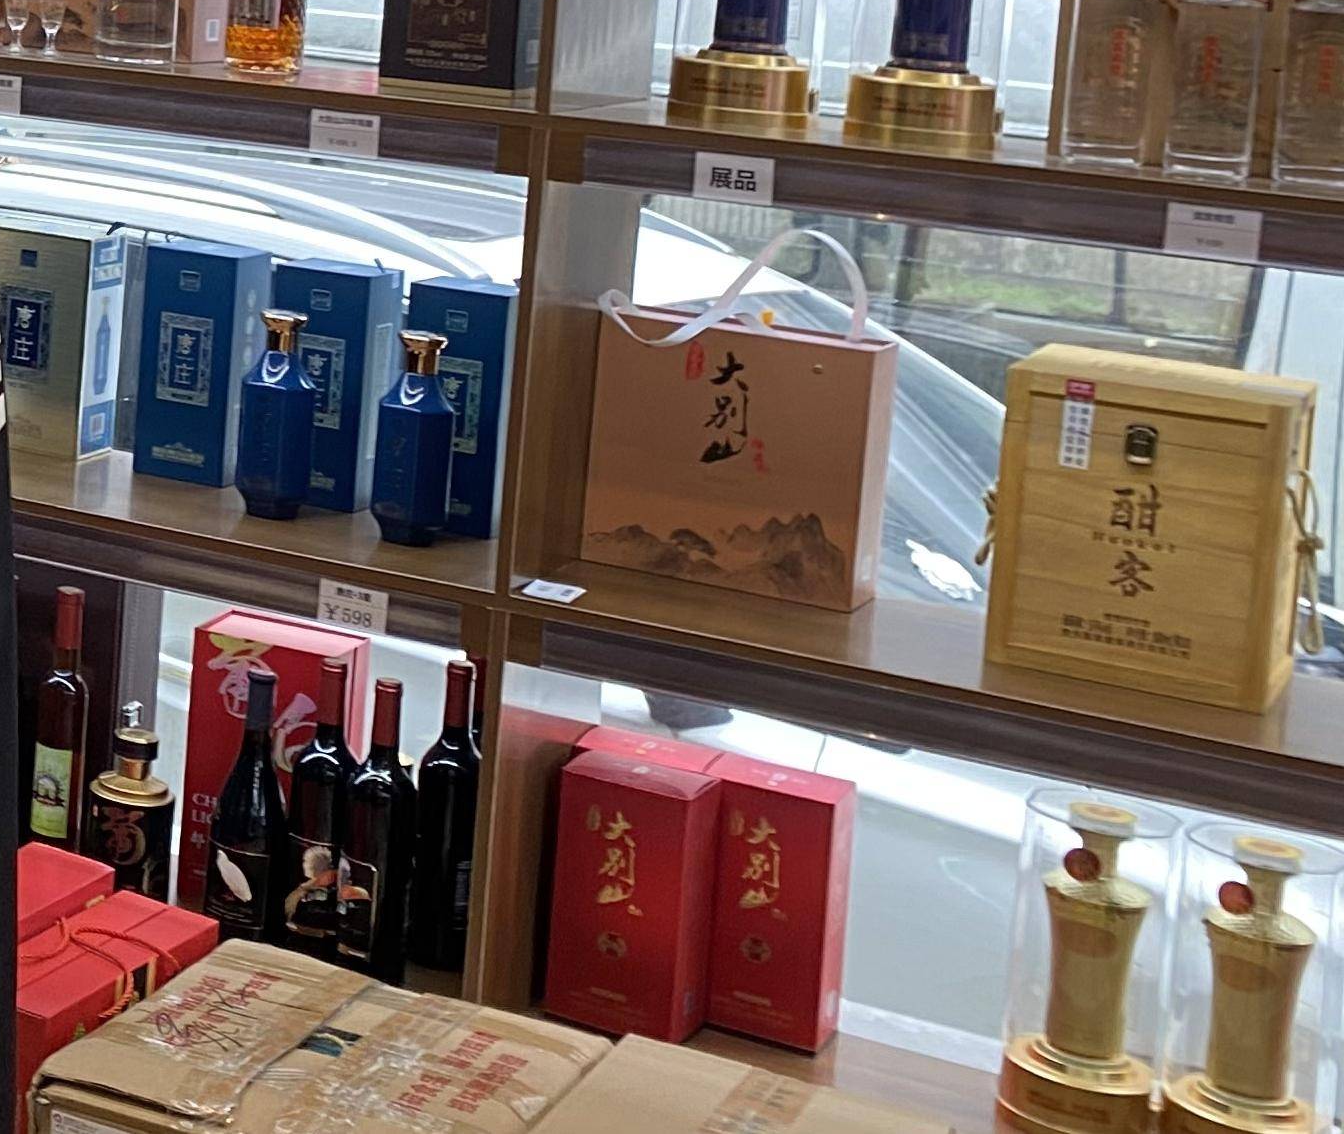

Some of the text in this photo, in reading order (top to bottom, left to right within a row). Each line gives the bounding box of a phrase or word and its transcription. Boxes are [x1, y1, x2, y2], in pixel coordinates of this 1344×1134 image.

[708, 167, 758, 193] 展品
[699, 351, 750, 464] 大别山
